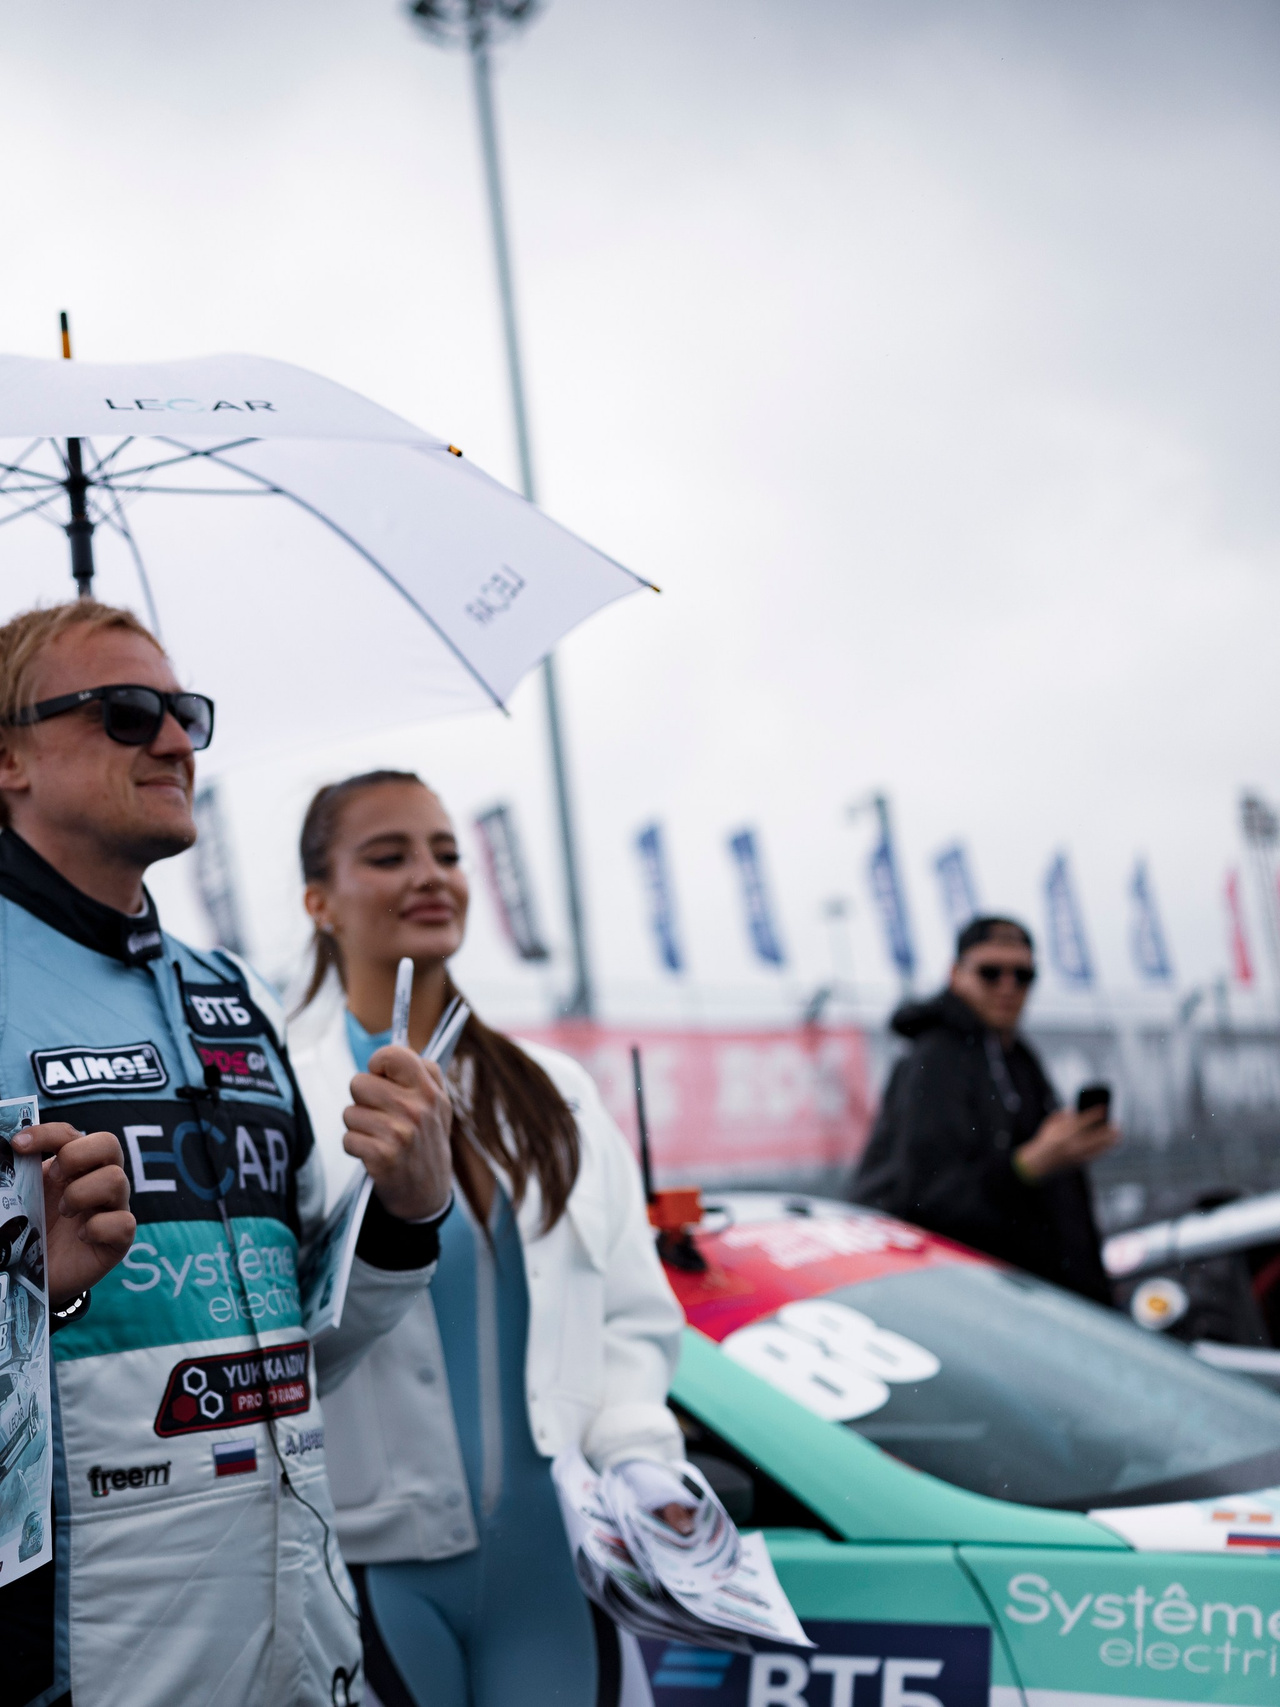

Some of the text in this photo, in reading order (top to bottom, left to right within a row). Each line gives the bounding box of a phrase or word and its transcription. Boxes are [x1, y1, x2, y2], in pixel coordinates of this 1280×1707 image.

[105, 396, 278, 414] LECAR
[190, 995, 252, 1027] ВТБ
[122, 1119, 290, 1201] ECAR
[120, 1232, 296, 1299] Systême
[721, 1298, 942, 1422] 88
[7, 1406, 25, 1435] LECAR
[88, 1461, 172, 1498] freem
